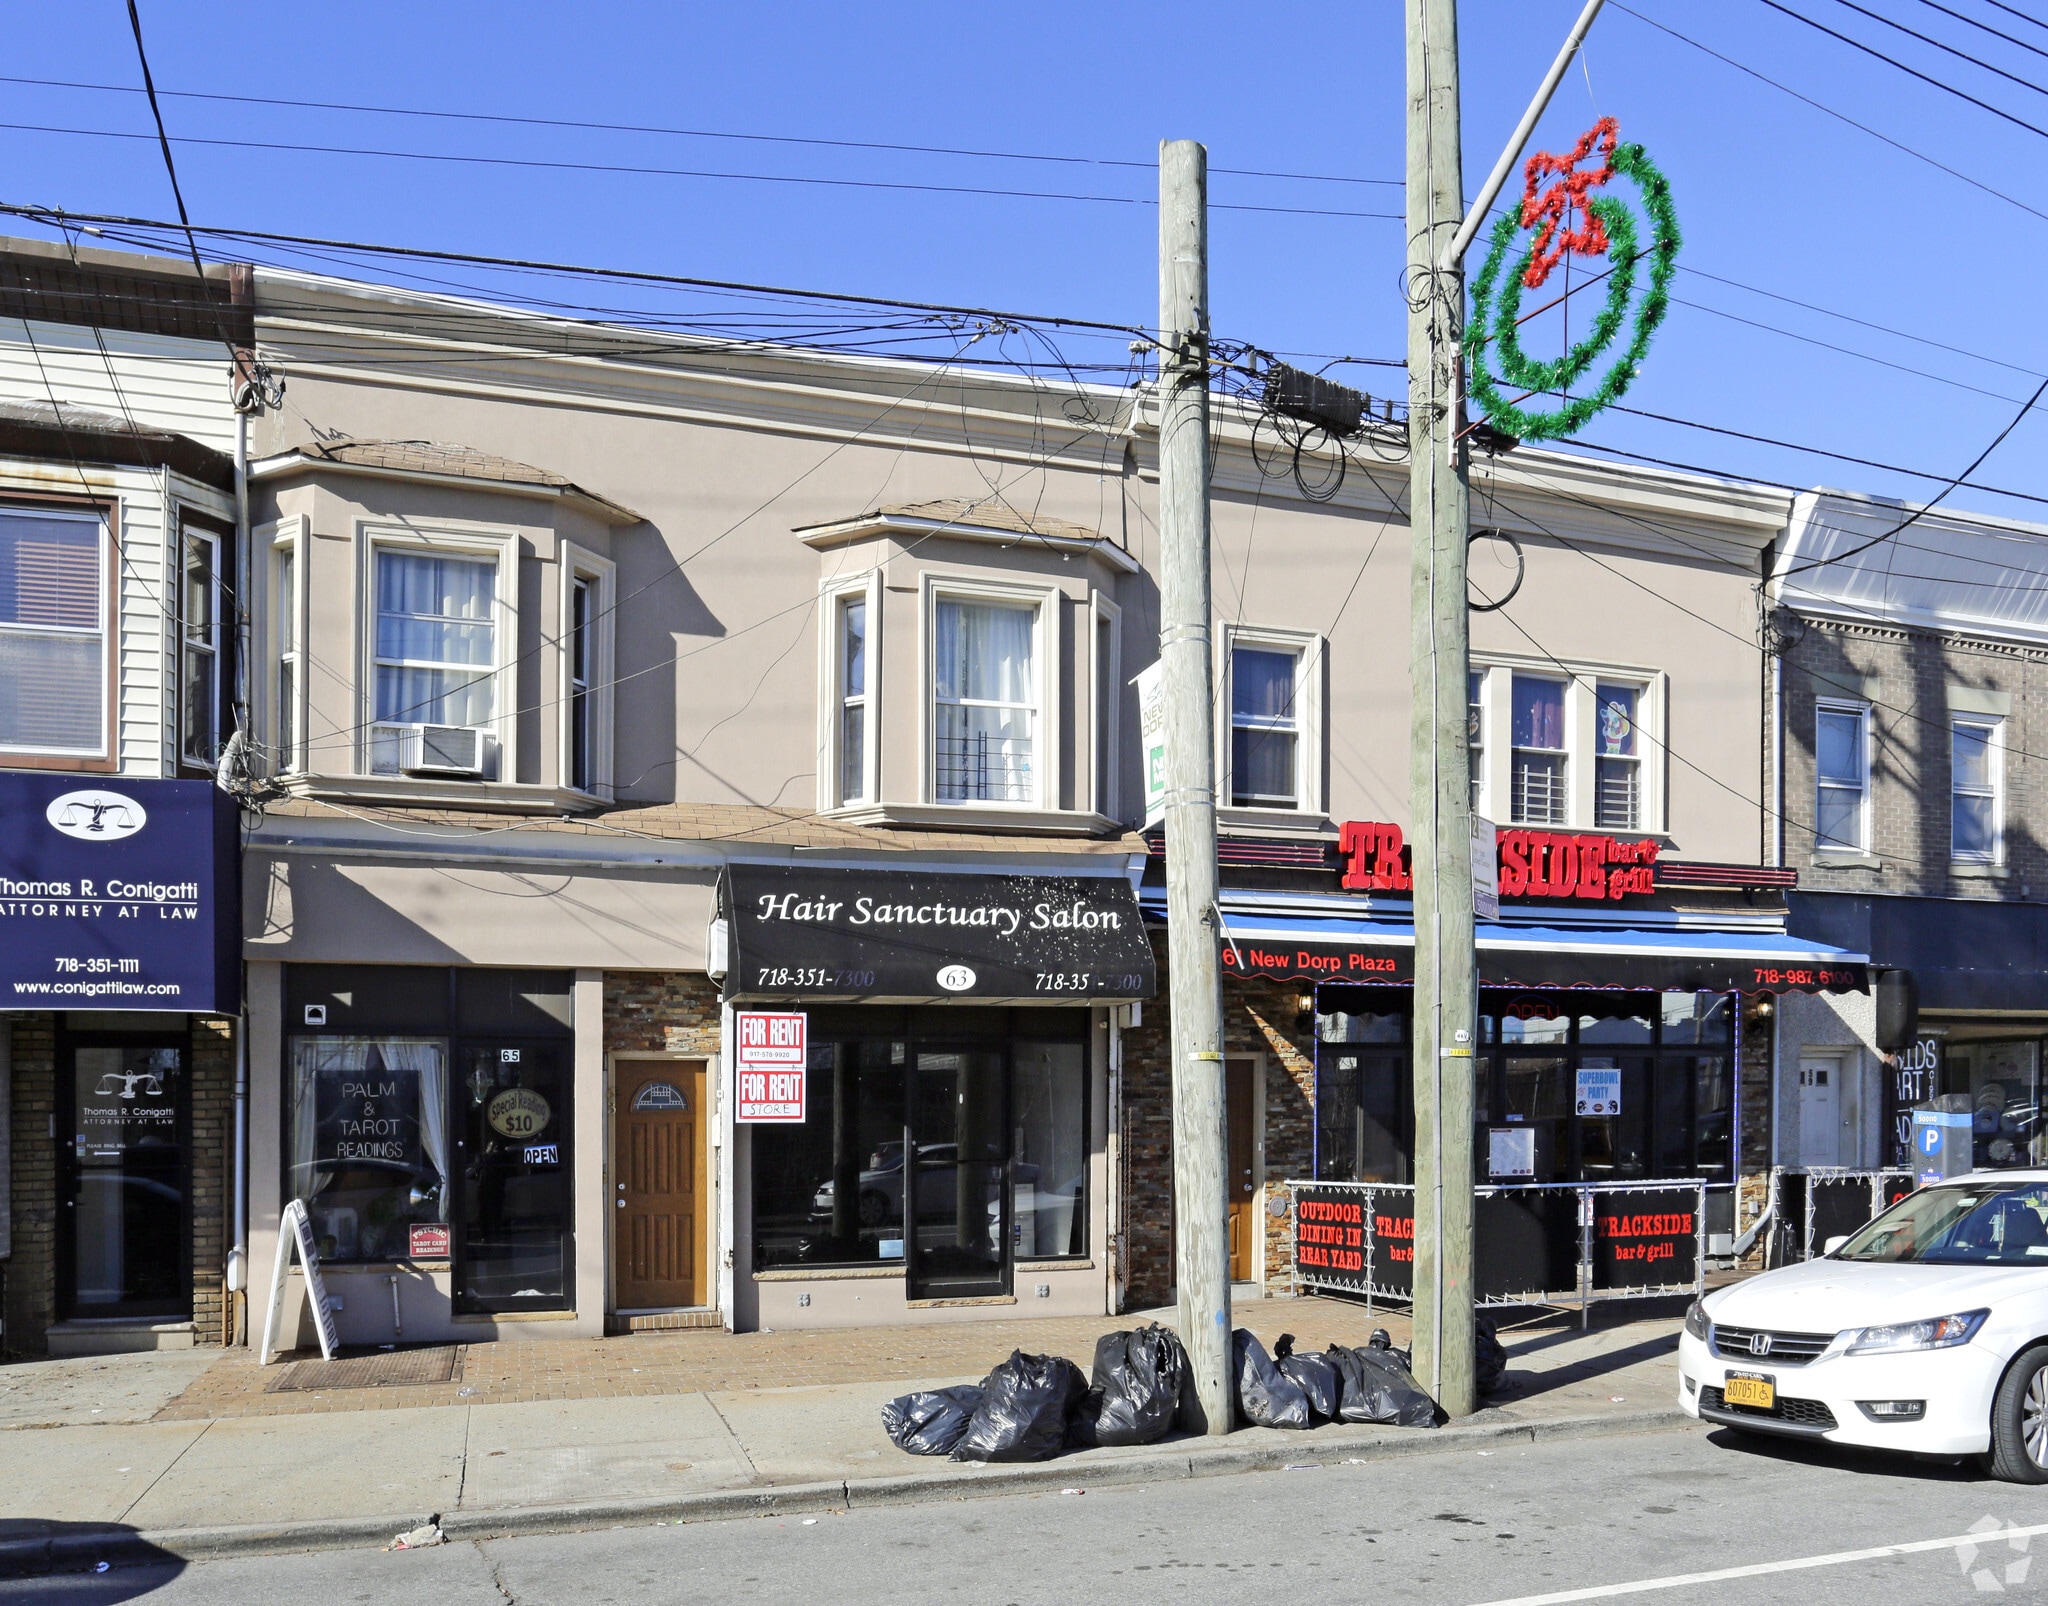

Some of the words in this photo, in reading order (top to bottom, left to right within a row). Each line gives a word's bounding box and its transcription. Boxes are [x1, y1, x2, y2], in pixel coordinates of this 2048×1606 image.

[1604, 836, 1638, 863] bar
[1339, 821, 1605, 899] TRSIDE
[81, 880, 97, 897] R.
[107, 880, 198, 902] Conigatti
[1608, 867, 1655, 900] grill
[119, 906, 139, 918] AT
[160, 907, 198, 919] LAW
[756, 893, 844, 922] Hair
[849, 897, 1023, 935] Sanctuary
[1030, 902, 1122, 930] Salon
[55, 958, 139, 973] 718-351-1111
[1250, 950, 1290, 968] New
[1297, 952, 1341, 972] Dorp
[1349, 953, 1396, 972] Plaza
[946, 970, 968, 987] 63
[14, 981, 180, 996] www.conigattilaw.com
[742, 1018, 766, 1045] FOR
[770, 1018, 802, 1046] RENT
[502, 1050, 519, 1061] 65
[741, 1073, 766, 1101] FOR
[769, 1073, 802, 1101] RENT
[1578, 1072, 1619, 1085] SUPERBOWL
[342, 1081, 396, 1098] PALM
[1587, 1087, 1609, 1099] PARTY
[83, 1108, 117, 1116] Thomas
[121, 1108, 129, 1116] R.
[133, 1108, 174, 1117] Conigatti
[363, 1101, 375, 1116] &
[750, 1104, 791, 1115] STORE
[340, 1119, 400, 1136] TAROT
[506, 1114, 533, 1135] $10
[1926, 1130, 1938, 1151] P
[337, 1142, 403, 1158] READINGS
[524, 1147, 558, 1163] OPEN
[1300, 1201, 1362, 1223] OUTDOOR
[412, 1226, 447, 1240] PSYCHIC
[1598, 1213, 1692, 1238] TRACKSIDE
[1299, 1224, 1343, 1245] DINING
[1346, 1228, 1362, 1247] IN
[1299, 1246, 1328, 1267] REAR
[1331, 1248, 1362, 1271] YARD
[1615, 1245, 1636, 1260] bar
[1647, 1243, 1674, 1262] grill
[1727, 1381, 1757, 1399] 607051
